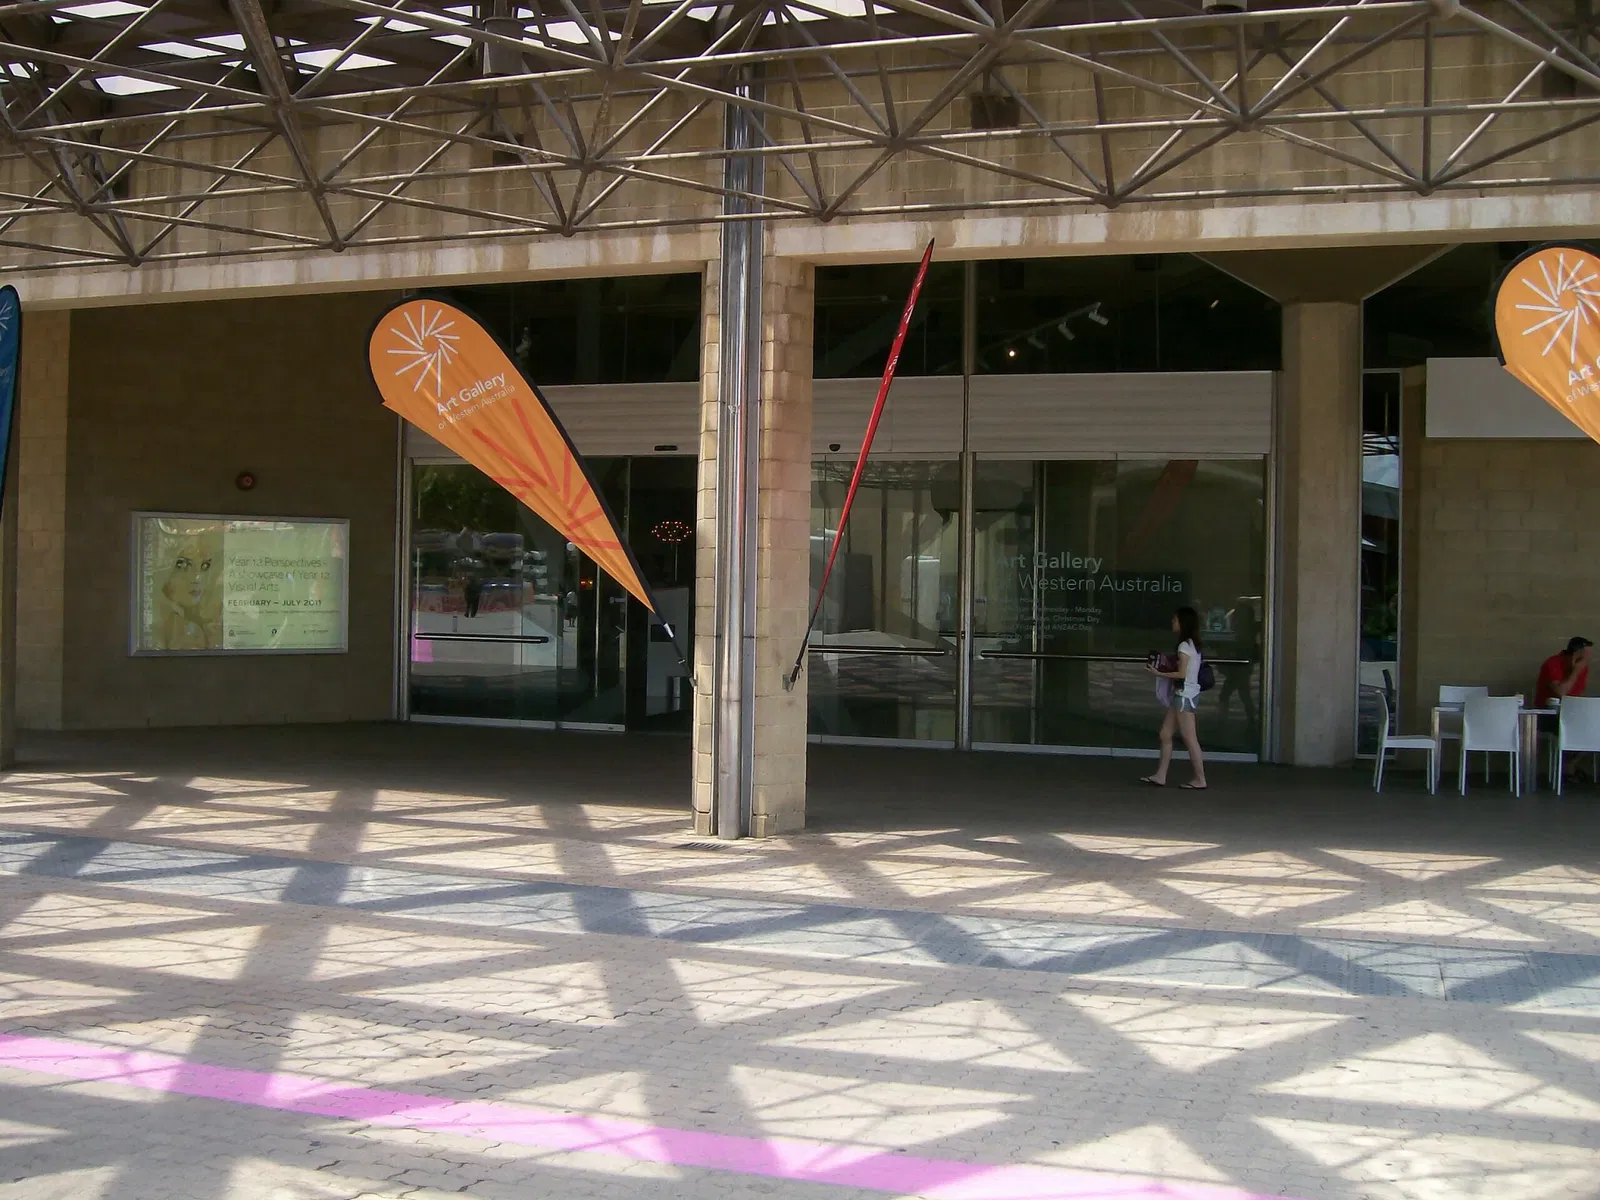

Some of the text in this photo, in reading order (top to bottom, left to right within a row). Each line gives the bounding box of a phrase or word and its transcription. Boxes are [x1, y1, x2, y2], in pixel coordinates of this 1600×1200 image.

[1568, 363, 1595, 386] Art
[437, 372, 506, 416] Art Gallery
[1566, 389, 1577, 403] of
[438, 384, 516, 430] of Western Australia
[228, 556, 249, 567] Year
[252, 558, 262, 567] 12
[264, 556, 322, 569] Perspectives
[996, 551, 1104, 574] Art Gallery
[228, 570, 235, 579] A
[238, 569, 284, 580] showcase
[286, 569, 295, 580] of
[299, 570, 318, 580] Year
[143, 543, 153, 632] PERSPECTIVES
[228, 581, 280, 592] Visual Arts
[1018, 572, 1096, 591] Western
[1099, 573, 1184, 593] Australia
[228, 599, 271, 607] FEBRUARY
[281, 599, 301, 607] JULY
[303, 599, 322, 607] 2011
[1075, 605, 1102, 615] Monday
[1052, 623, 1078, 631] ANZAC
